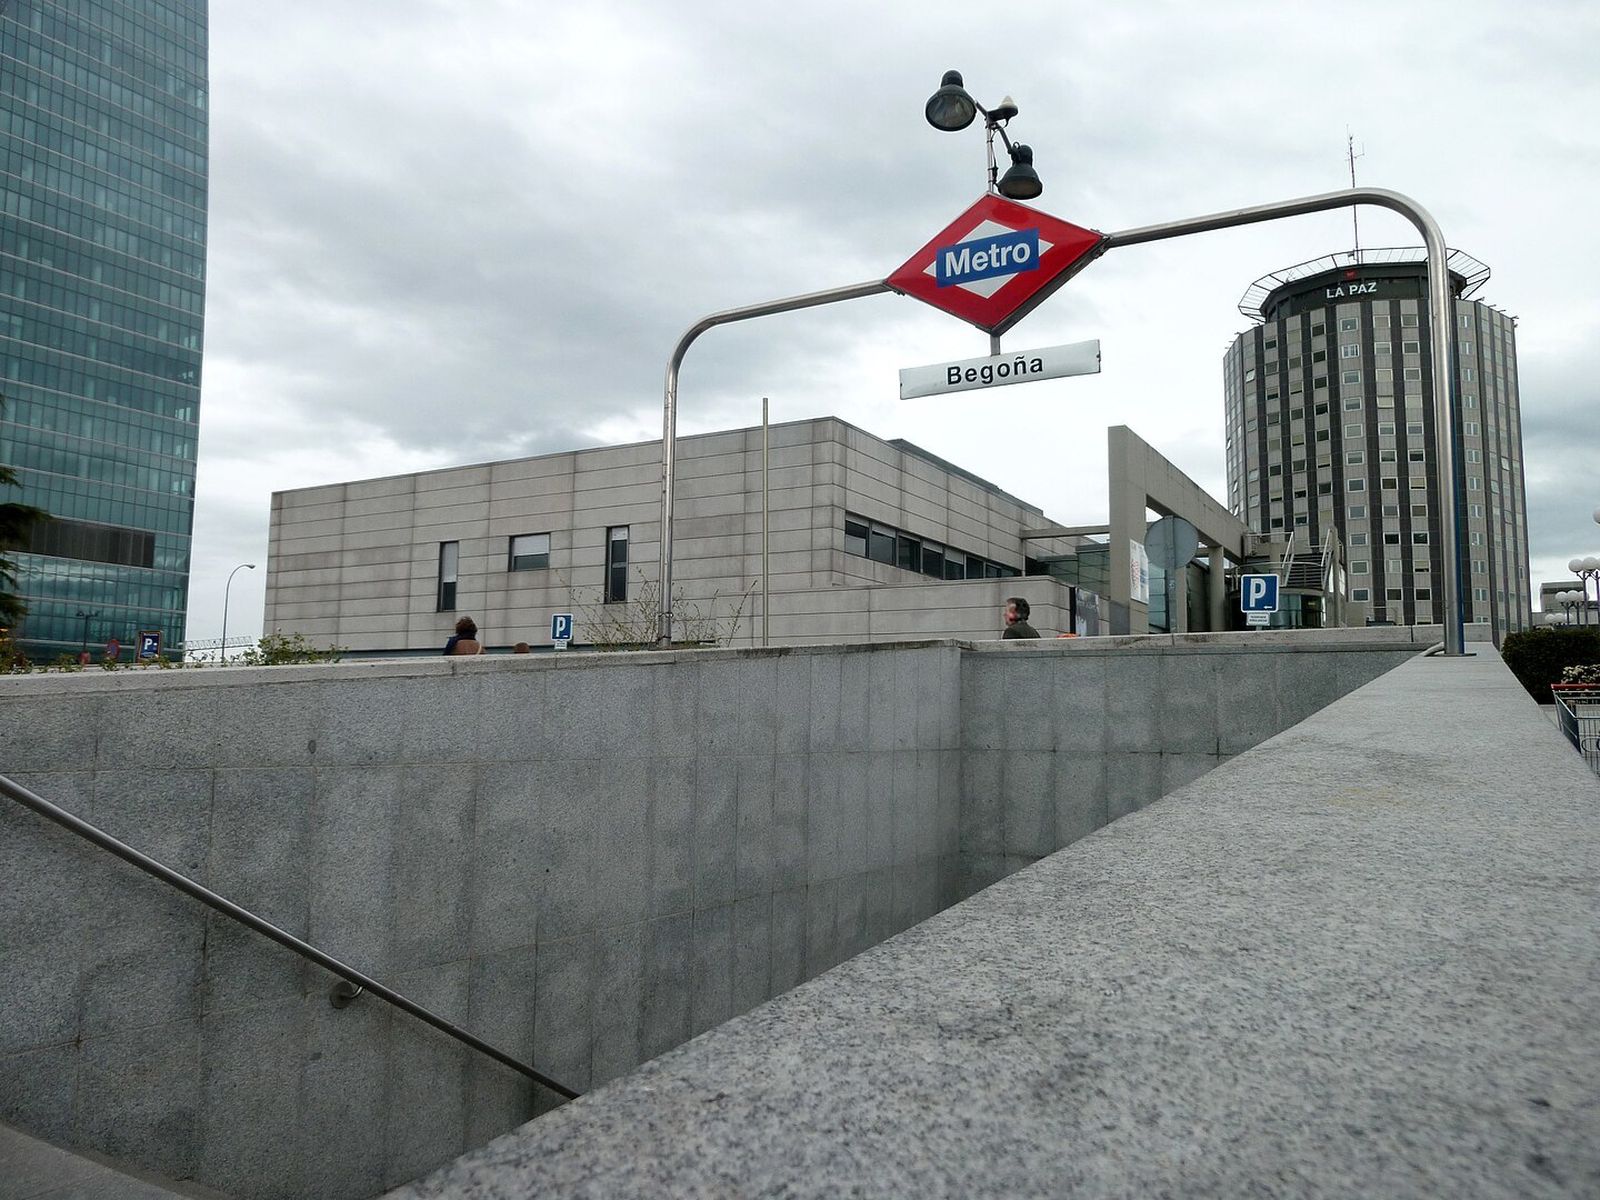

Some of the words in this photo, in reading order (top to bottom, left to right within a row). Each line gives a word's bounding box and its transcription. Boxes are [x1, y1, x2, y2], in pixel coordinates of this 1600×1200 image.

[945, 241, 1030, 277] Metro
[1326, 287, 1345, 299] LA
[1349, 282, 1376, 295] PAZ
[947, 355, 1043, 385] Begoña
[1249, 578, 1266, 608] P
[556, 616, 566, 637] P
[144, 638, 153, 650] P
